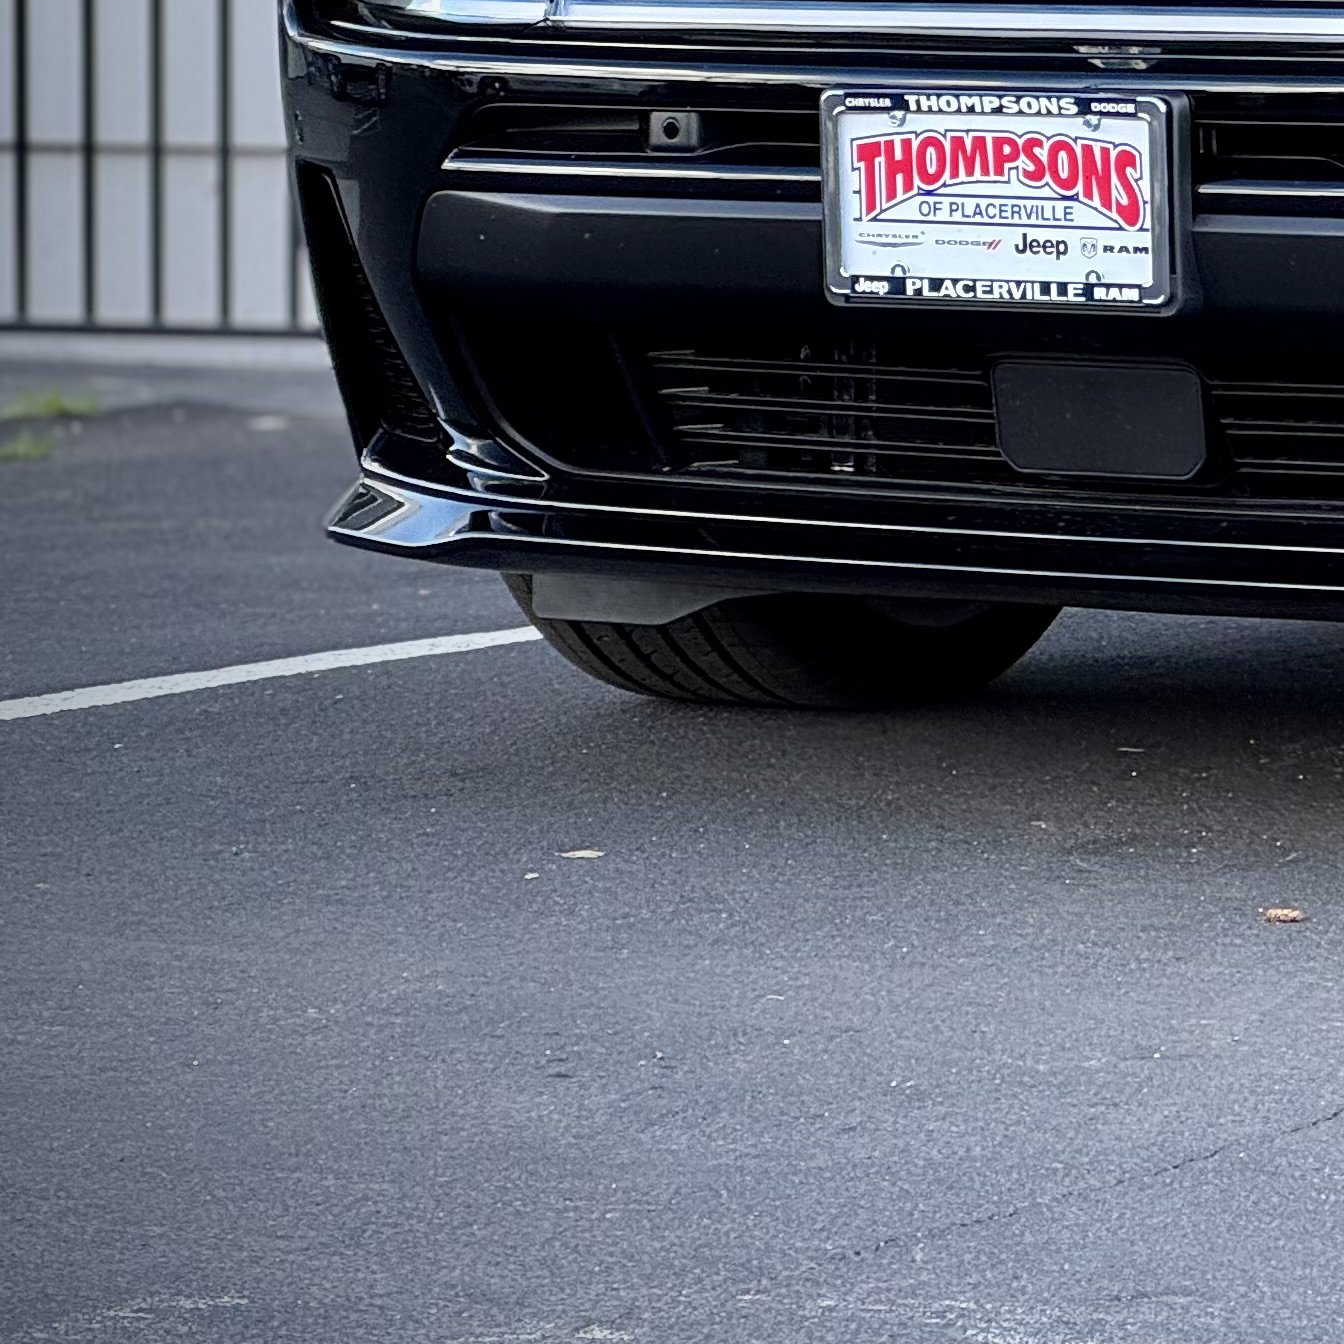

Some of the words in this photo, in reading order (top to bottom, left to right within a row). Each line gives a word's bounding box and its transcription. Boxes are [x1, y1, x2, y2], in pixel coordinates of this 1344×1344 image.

[845, 97, 892, 107] CHRYSLER
[904, 94, 1078, 115] THOMPSONS
[1090, 102, 1136, 113] DODGE
[855, 133, 1144, 229] THOMPSONS
[918, 200, 943, 217] OF
[949, 201, 1075, 222] PLACERVILLE
[858, 232, 919, 240] CHRYSLER
[1014, 233, 1069, 260] Jeep
[1102, 244, 1149, 255] RAM
[854, 277, 889, 295] Jeep
[906, 278, 1086, 302] PLACERVILLE
[1093, 286, 1140, 302] RAM
